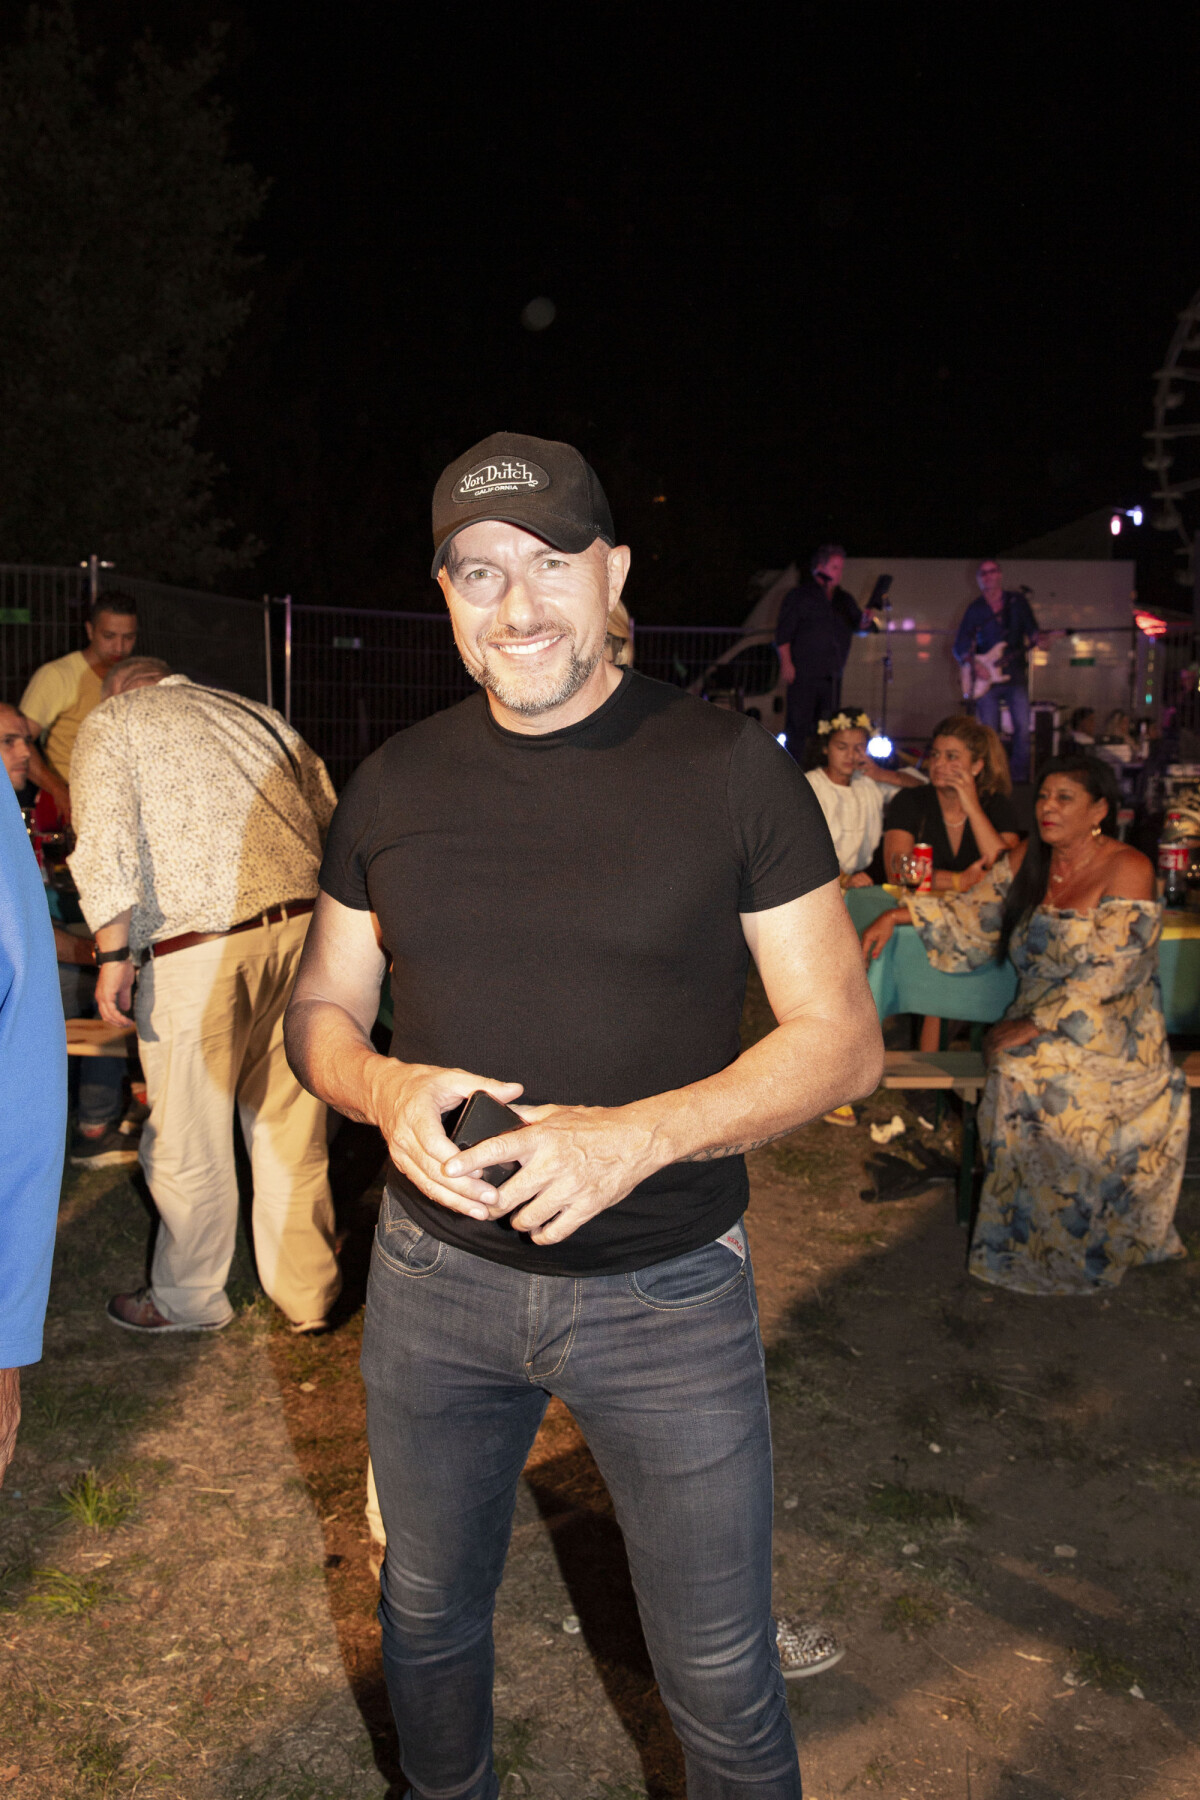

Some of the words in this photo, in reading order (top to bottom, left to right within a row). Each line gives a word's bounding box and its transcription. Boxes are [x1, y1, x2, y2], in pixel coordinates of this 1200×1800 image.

[460, 471, 486, 490] Von
[485, 462, 533, 483] Dutch
[474, 485, 518, 496] CALIFORNIA
